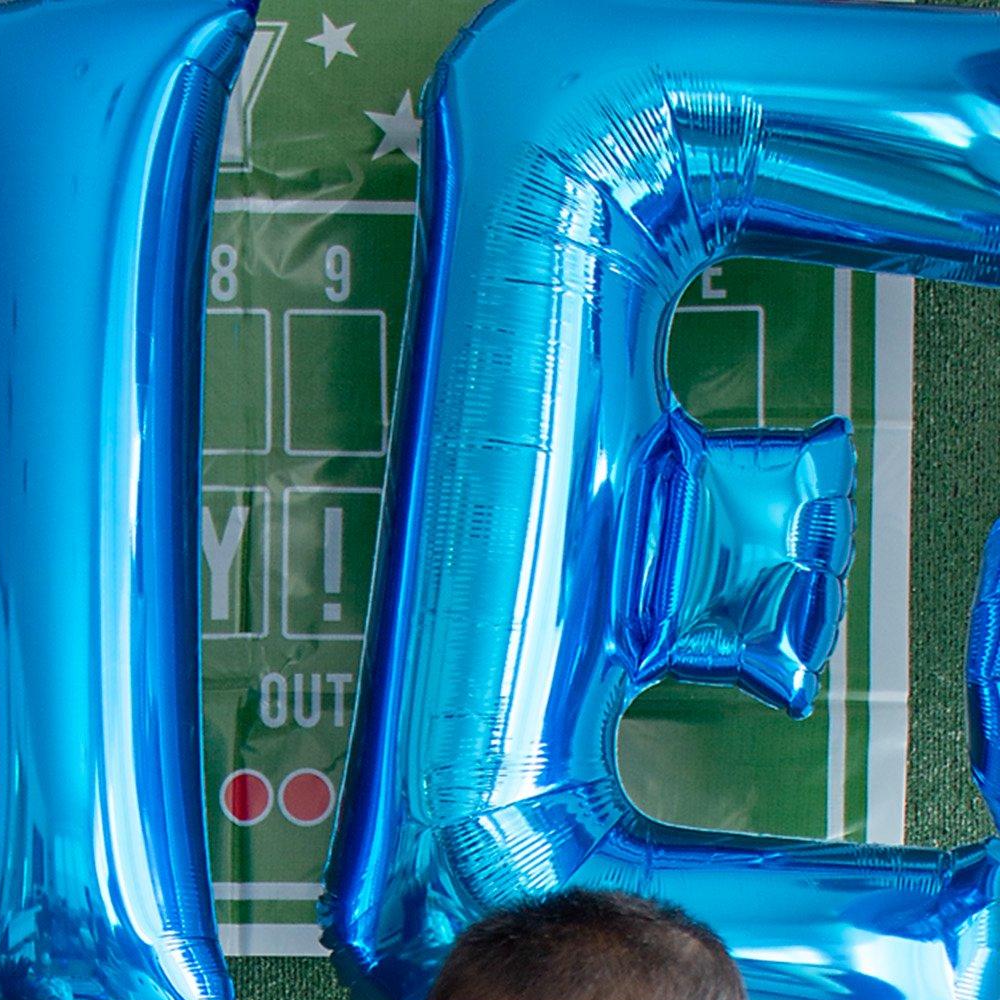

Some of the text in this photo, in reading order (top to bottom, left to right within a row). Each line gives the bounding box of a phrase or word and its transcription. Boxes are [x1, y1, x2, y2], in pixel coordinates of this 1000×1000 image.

[210, 243, 239, 303] 8
[324, 244, 351, 303] 9
[201, 506, 250, 621] Y
[259, 671, 354, 729] OUT
